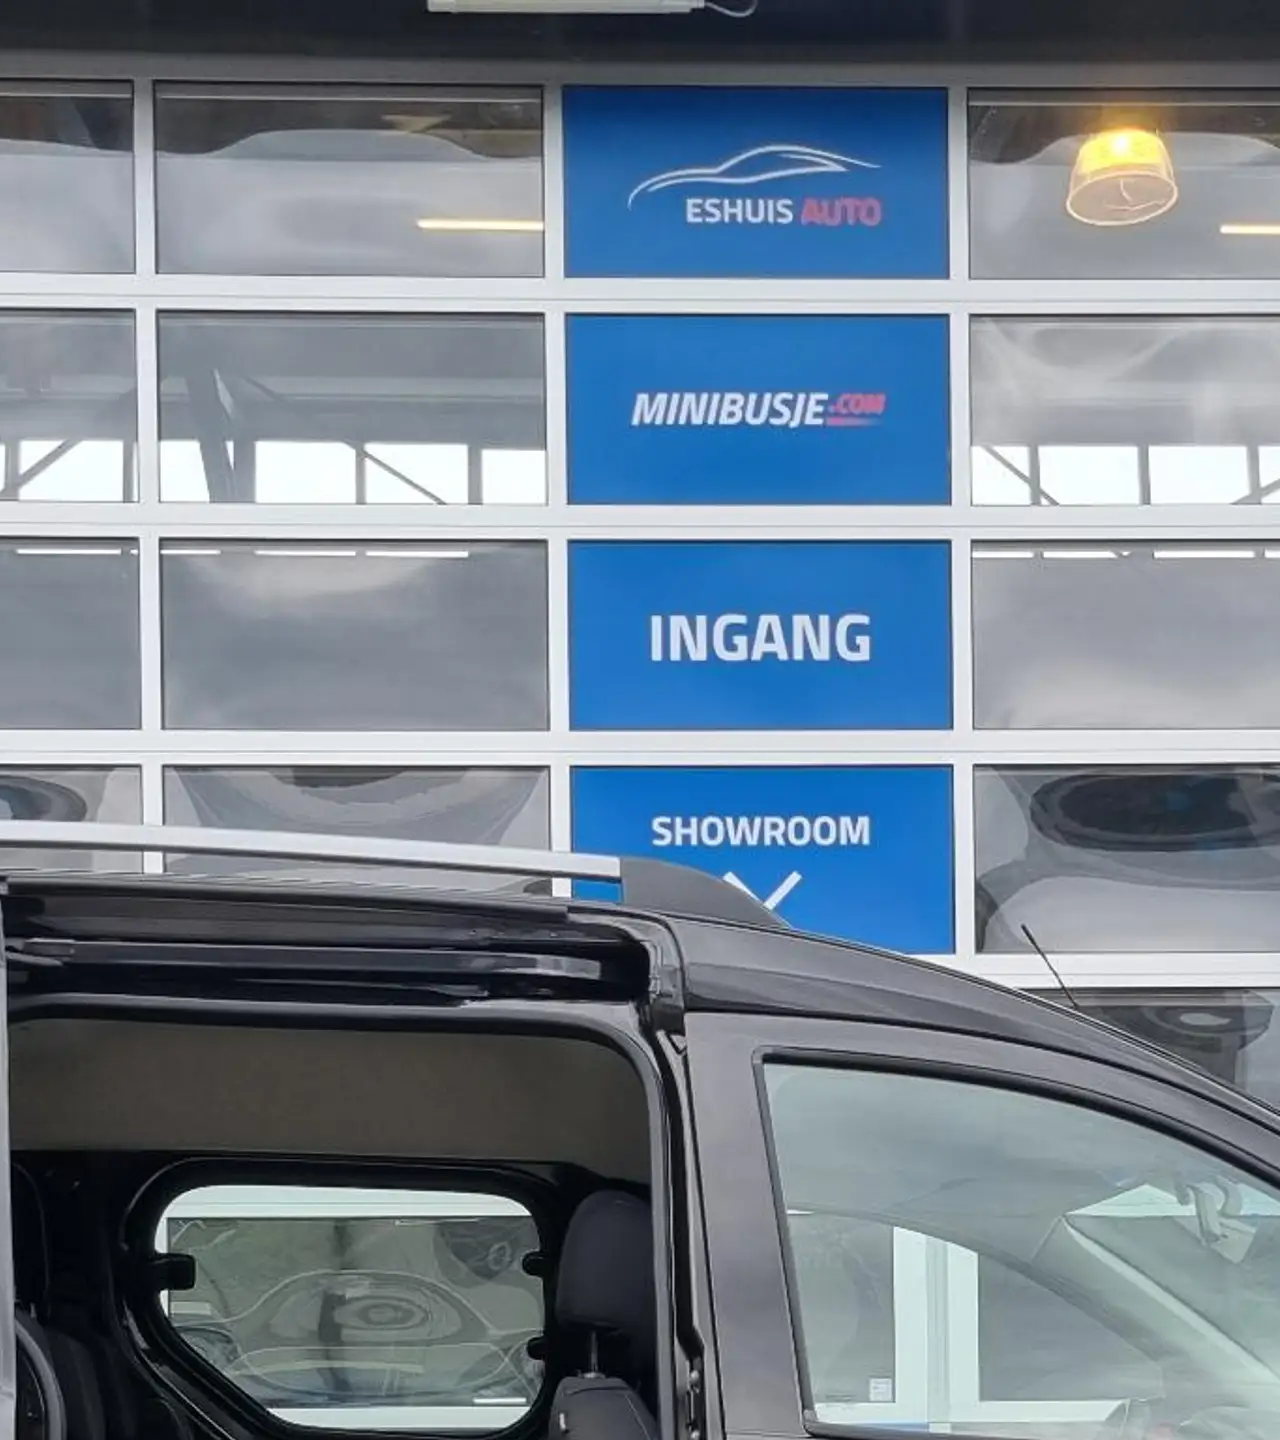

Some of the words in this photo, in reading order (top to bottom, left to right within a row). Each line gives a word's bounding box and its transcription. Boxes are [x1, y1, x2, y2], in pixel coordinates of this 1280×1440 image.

[686, 198, 794, 225] ESHUIS
[800, 197, 883, 227] AUTO
[650, 614, 871, 662] INGANG
[651, 815, 871, 847] SHOWROOM
